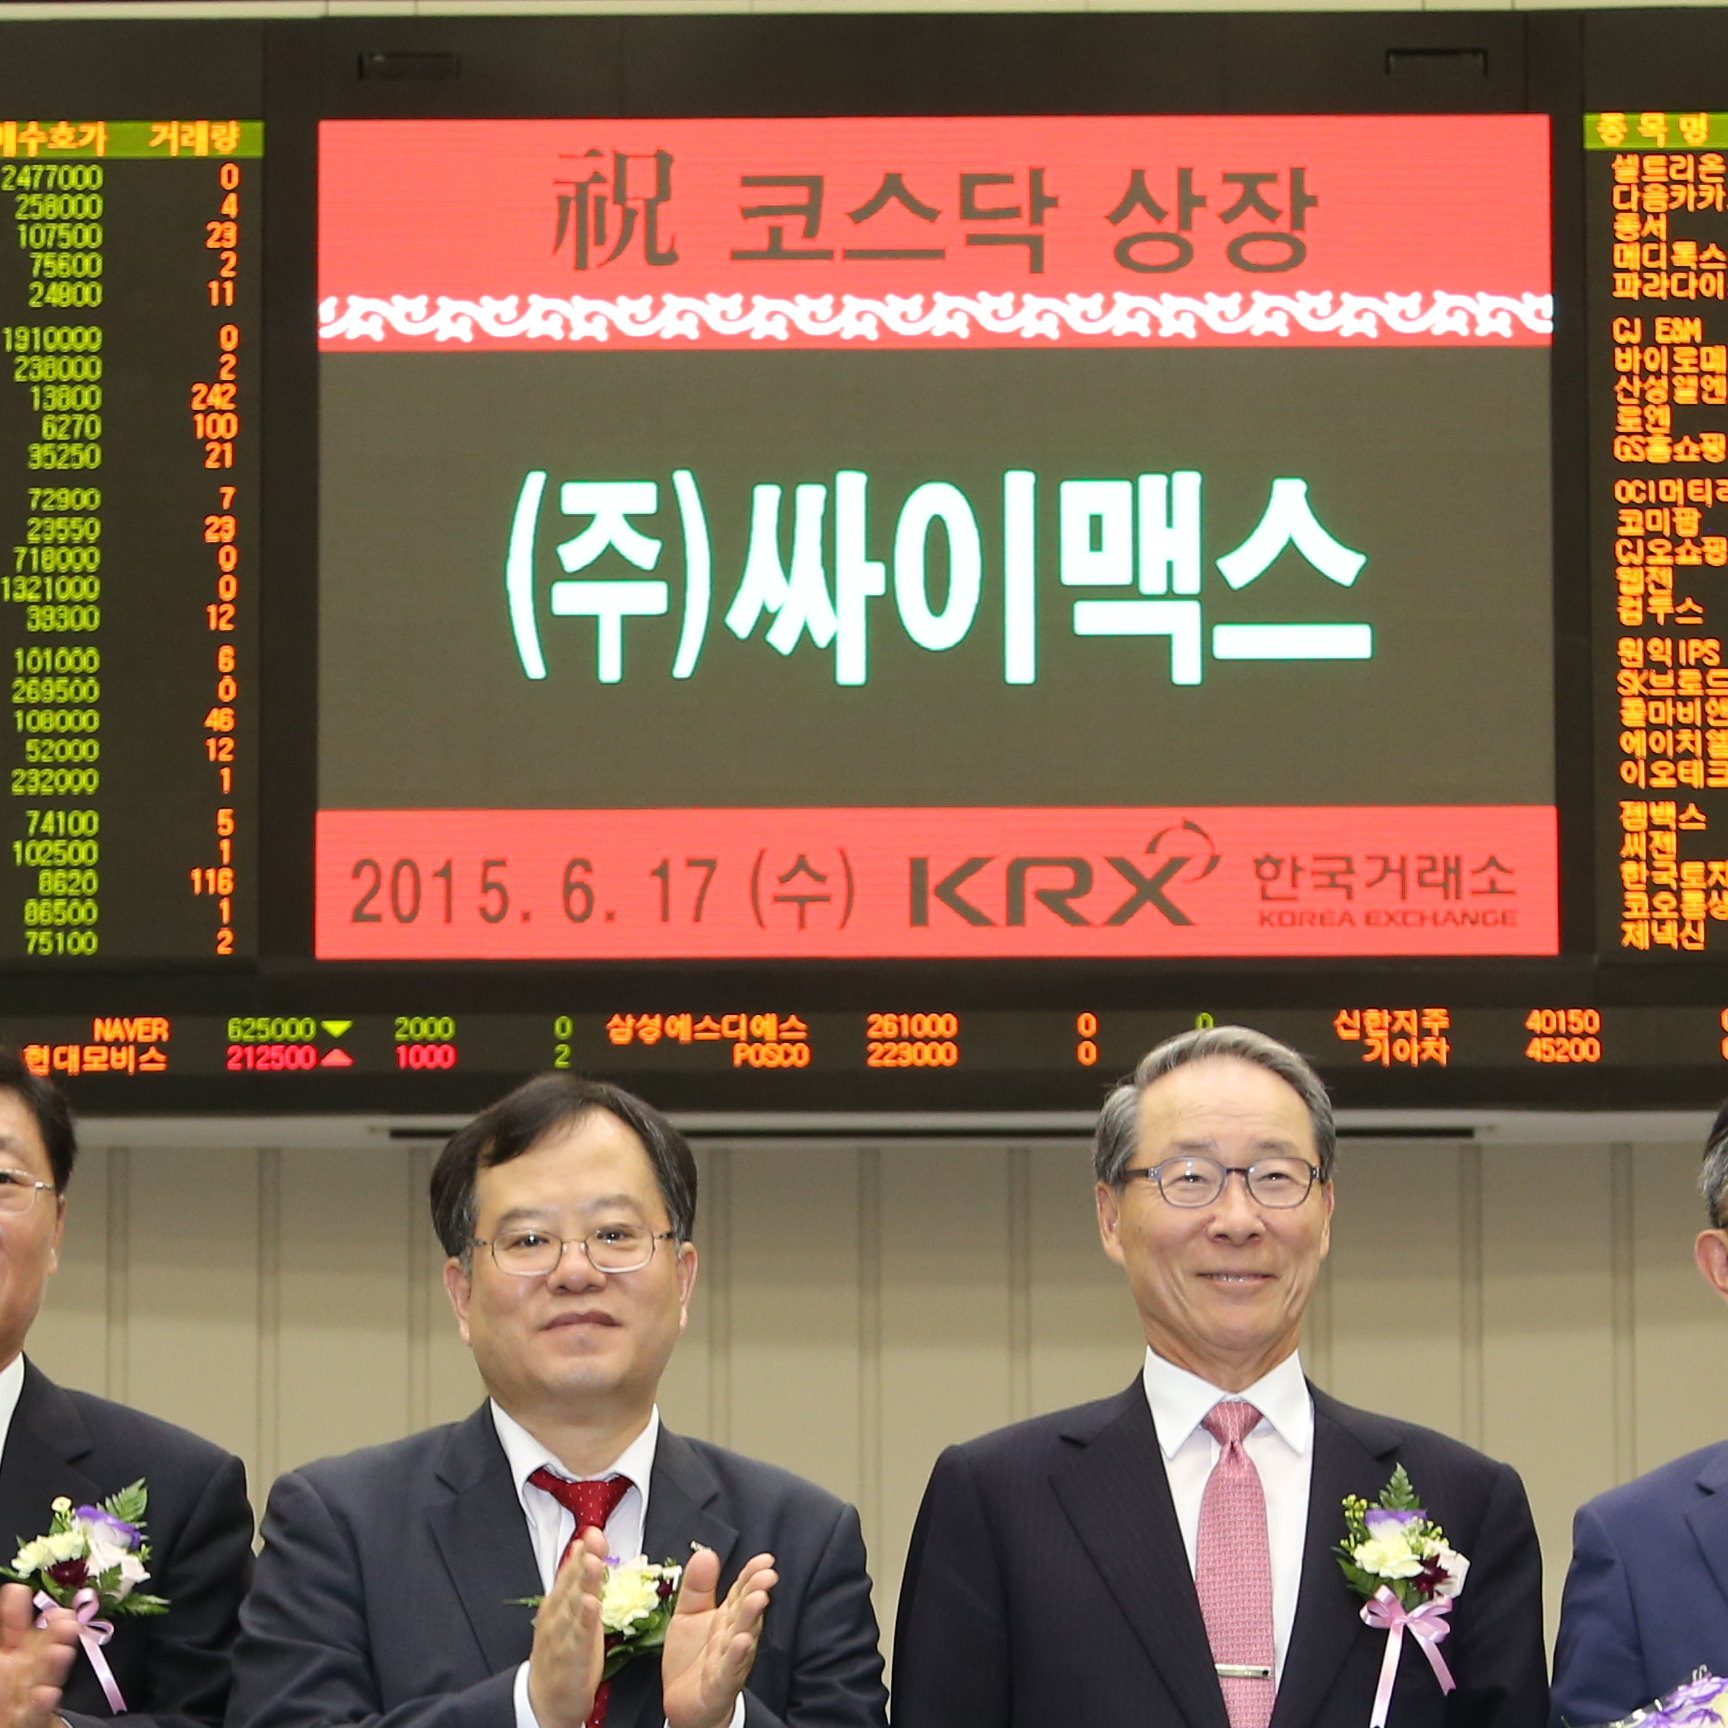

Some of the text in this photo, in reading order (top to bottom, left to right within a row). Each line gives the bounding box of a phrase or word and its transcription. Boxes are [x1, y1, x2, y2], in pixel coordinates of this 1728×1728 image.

[150, 121, 240, 156] 거래량
[552, 148, 1319, 274] 祝 코스닥 상장
[507, 468, 1373, 685] (주)싸이맥스
[350, 850, 1195, 933] 2015. 6. 17 (수) KRX
[1253, 852, 1515, 904] 한국거래소
[1257, 907, 1518, 928] KOREA EXCHANGE
[93, 1017, 170, 1043] NAVER
[228, 1018, 315, 1041] 625000
[395, 1017, 454, 1040] 2000
[606, 1013, 808, 1044] 삼성에스디에스
[867, 1013, 959, 1039] 261000
[1524, 1009, 1602, 1035] 40150
[226, 1045, 320, 1071] 212500
[396, 1044, 457, 1070] 1000
[733, 1040, 811, 1068] POSCO
[1360, 1033, 1450, 1067] 기아차
[1525, 1034, 1602, 1062] 45200
